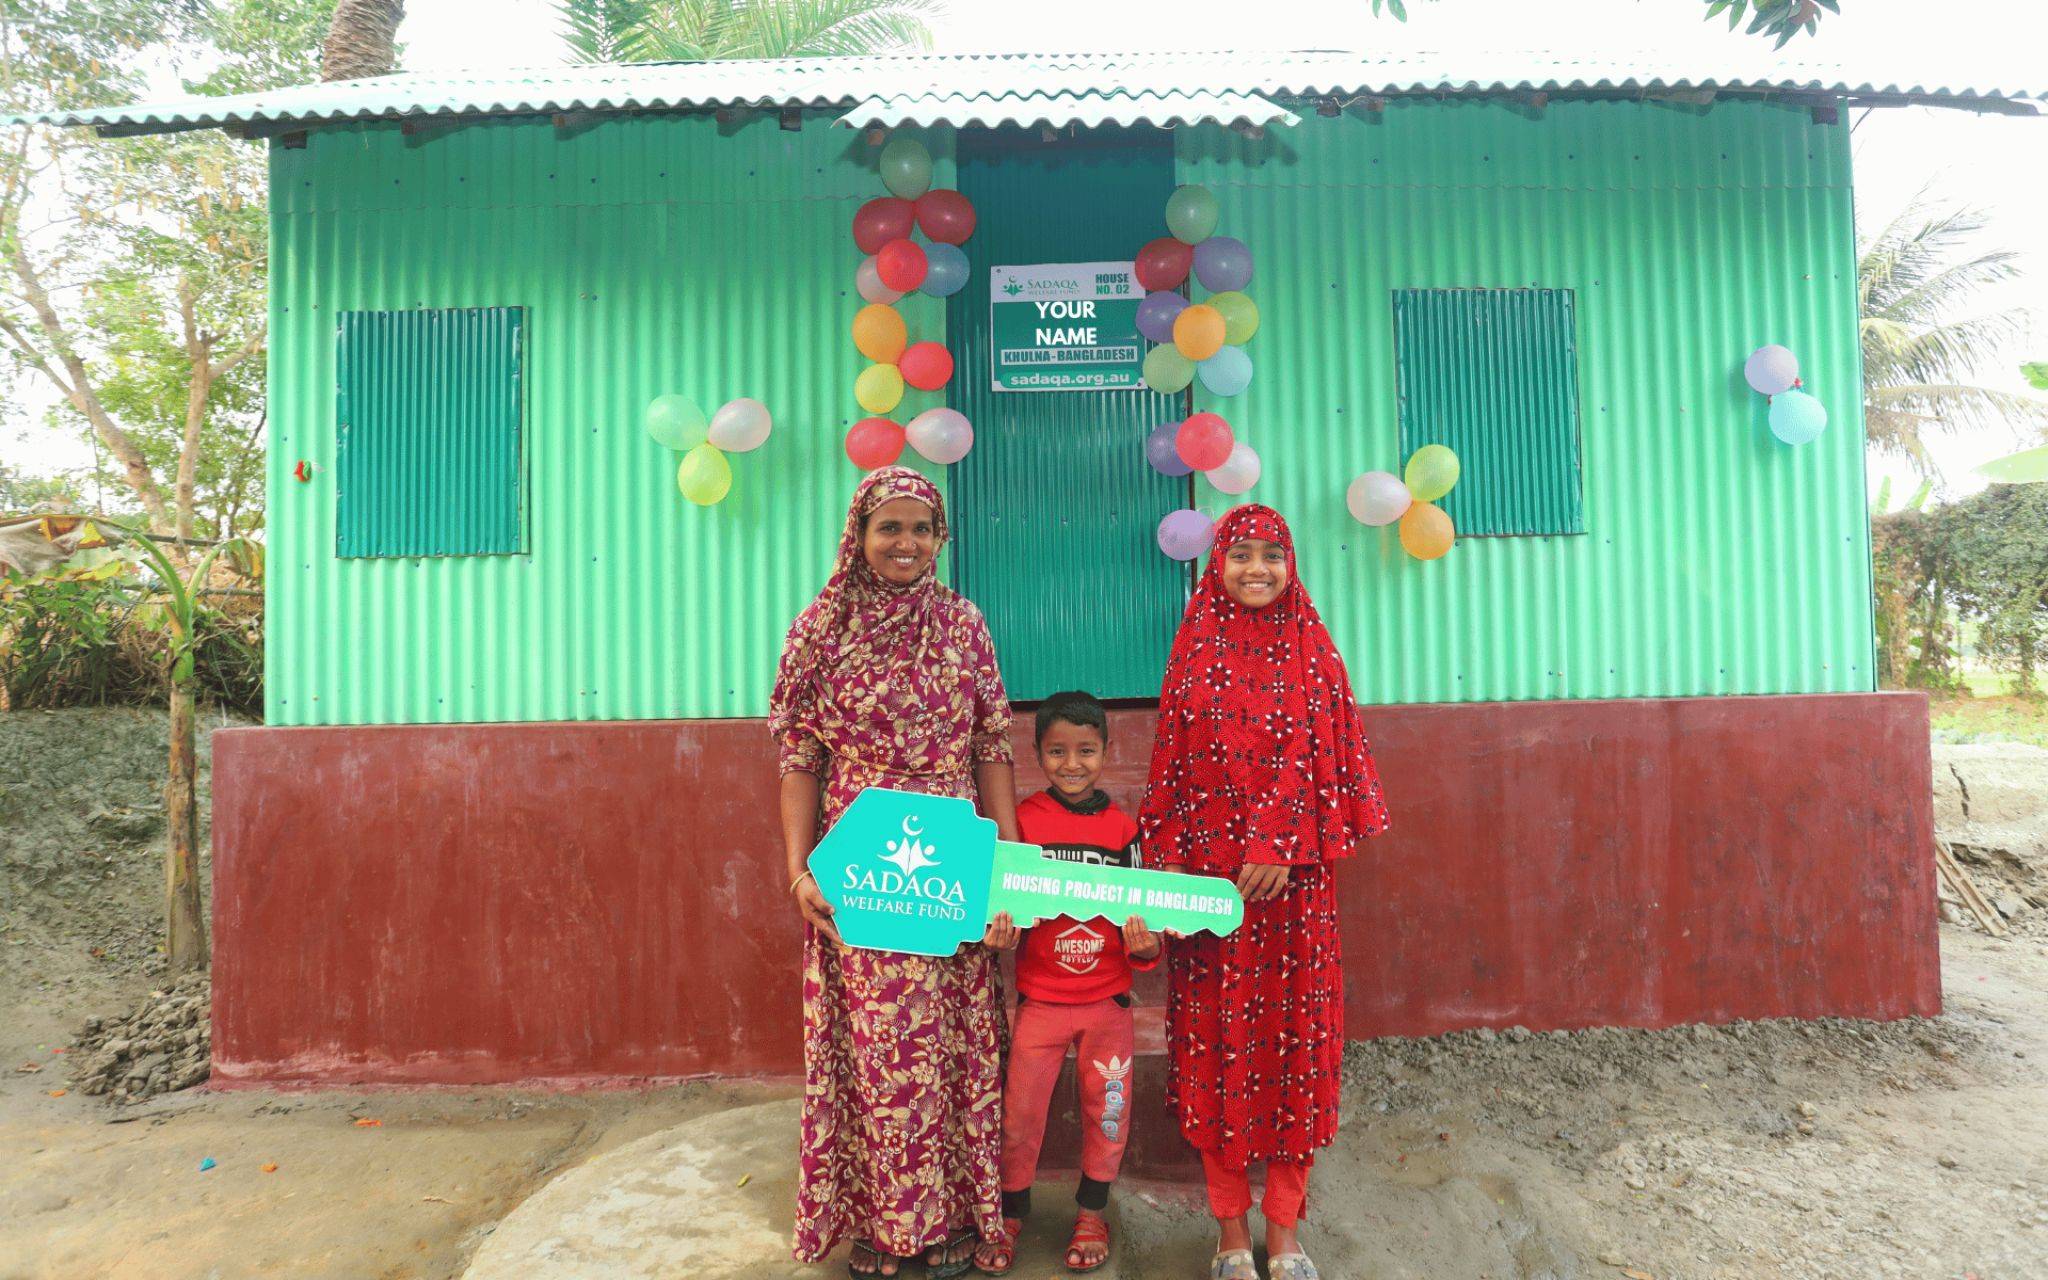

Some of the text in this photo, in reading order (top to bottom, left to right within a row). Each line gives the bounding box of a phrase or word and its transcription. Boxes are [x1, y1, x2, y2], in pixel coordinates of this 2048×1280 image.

[1027, 279, 1079, 290] SADAQA
[1096, 273, 1129, 284] HOUSE
[1096, 284, 1130, 295] NO. 02
[1004, 349, 1135, 363] KHULNA-BANGLADESH
[1010, 373, 1129, 386] sadaqa.org.au
[843, 863, 968, 907] SADAQA
[1002, 872, 1233, 916] HOUSING PROJECT IN BANGLADESH
[842, 894, 966, 921] WELFARE FUND
[1054, 938, 1105, 955] AWESOME
